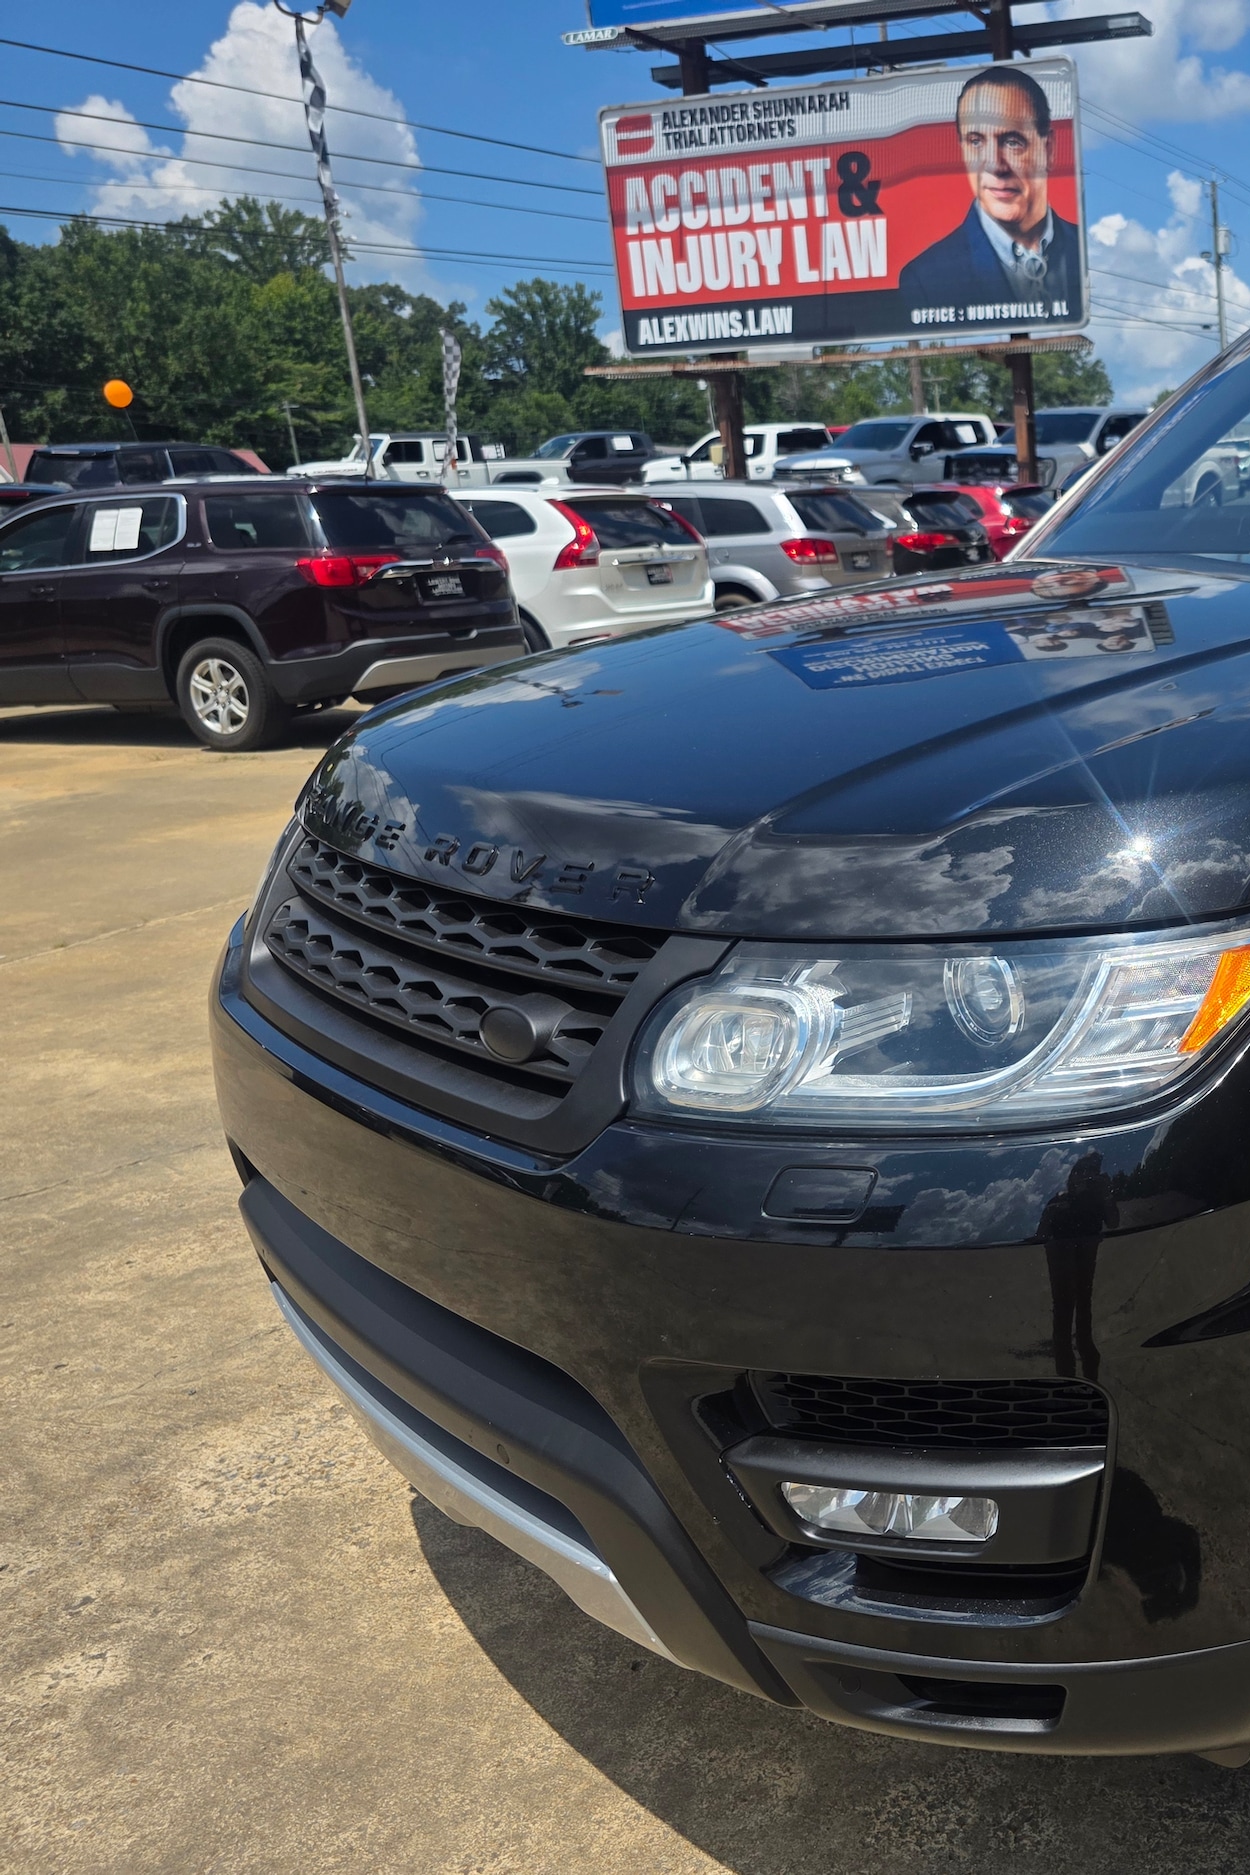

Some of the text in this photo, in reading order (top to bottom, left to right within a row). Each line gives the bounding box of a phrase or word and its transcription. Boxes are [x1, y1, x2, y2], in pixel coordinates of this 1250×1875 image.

[569, 29, 612, 43] LAMAR
[662, 91, 850, 131] ALEXANDER SHUNNARAH
[663, 119, 796, 151] TRIAL ATTORNEYS
[625, 151, 884, 236] ACCIDENT &
[627, 218, 888, 297] INJURY LAW
[638, 306, 793, 345] ALEXWINS.LAW
[911, 307, 955, 324] OFFICE
[966, 302, 1049, 321] HUNTSVILLE,
[1052, 300, 1069, 317] AL
[424, 833, 656, 904] ROVER
